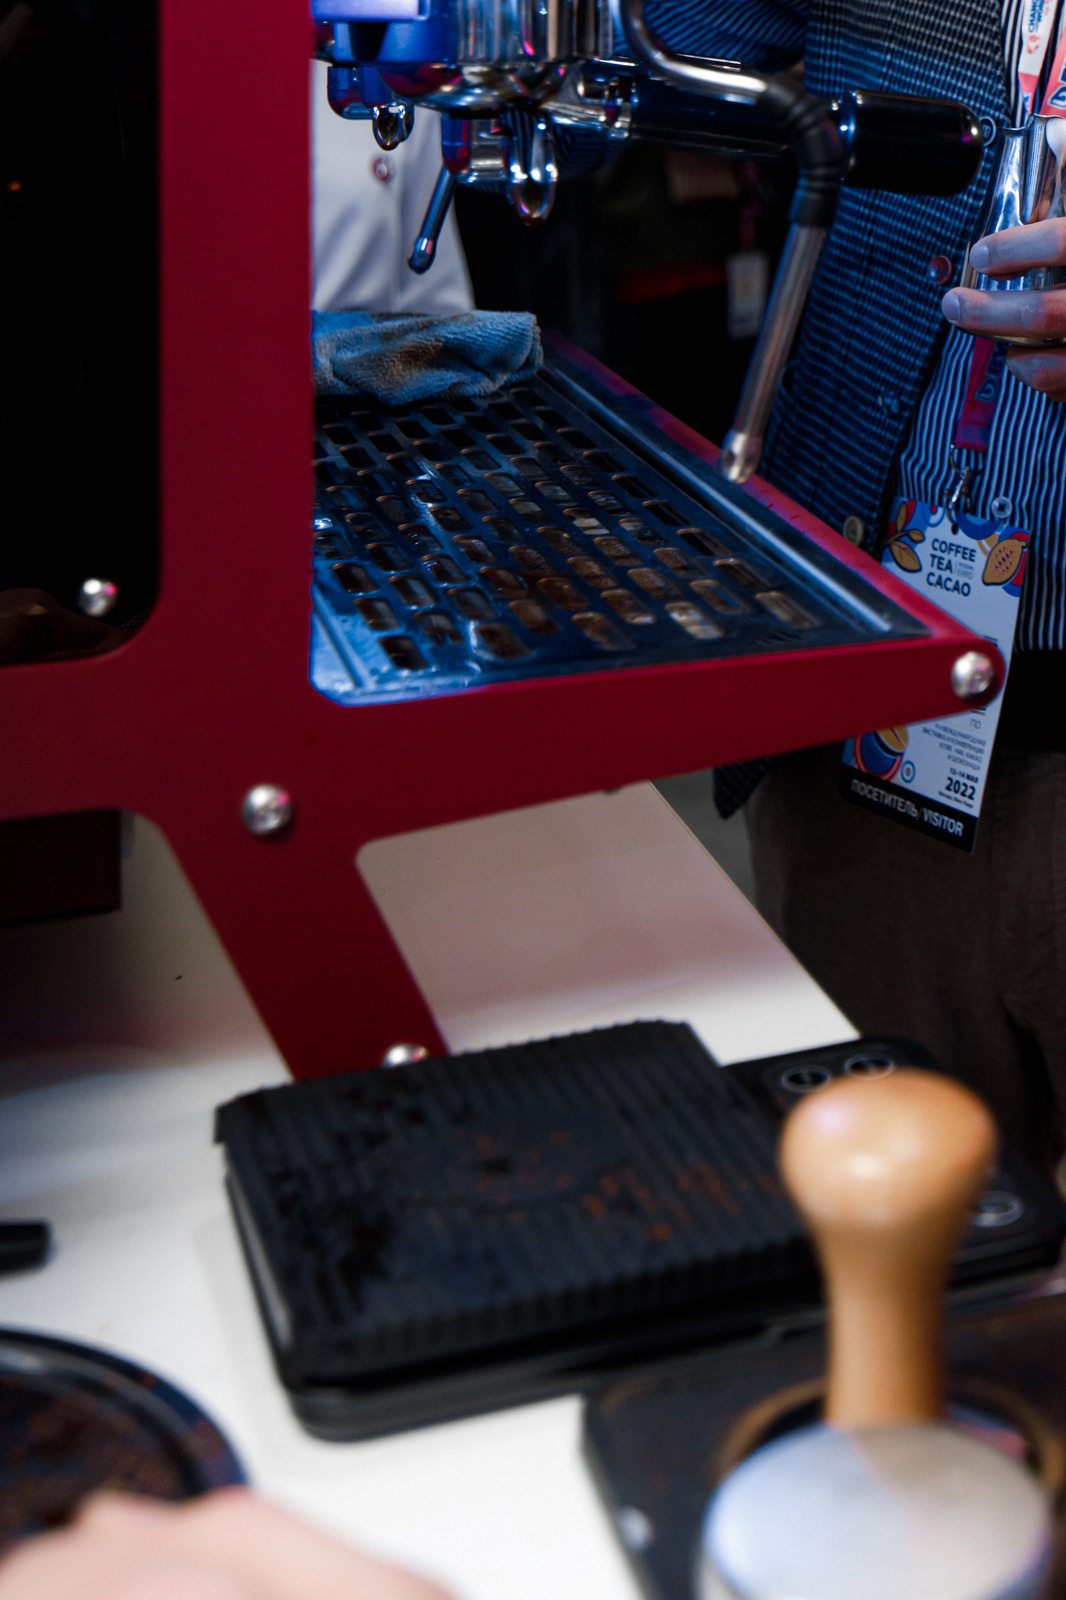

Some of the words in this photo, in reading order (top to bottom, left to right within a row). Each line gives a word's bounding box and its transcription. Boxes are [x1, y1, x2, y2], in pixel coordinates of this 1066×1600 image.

[931, 538, 976, 562] COFFEE
[930, 553, 953, 574] TEA
[926, 572, 971, 597] CACAO
[945, 776, 976, 800] 2022
